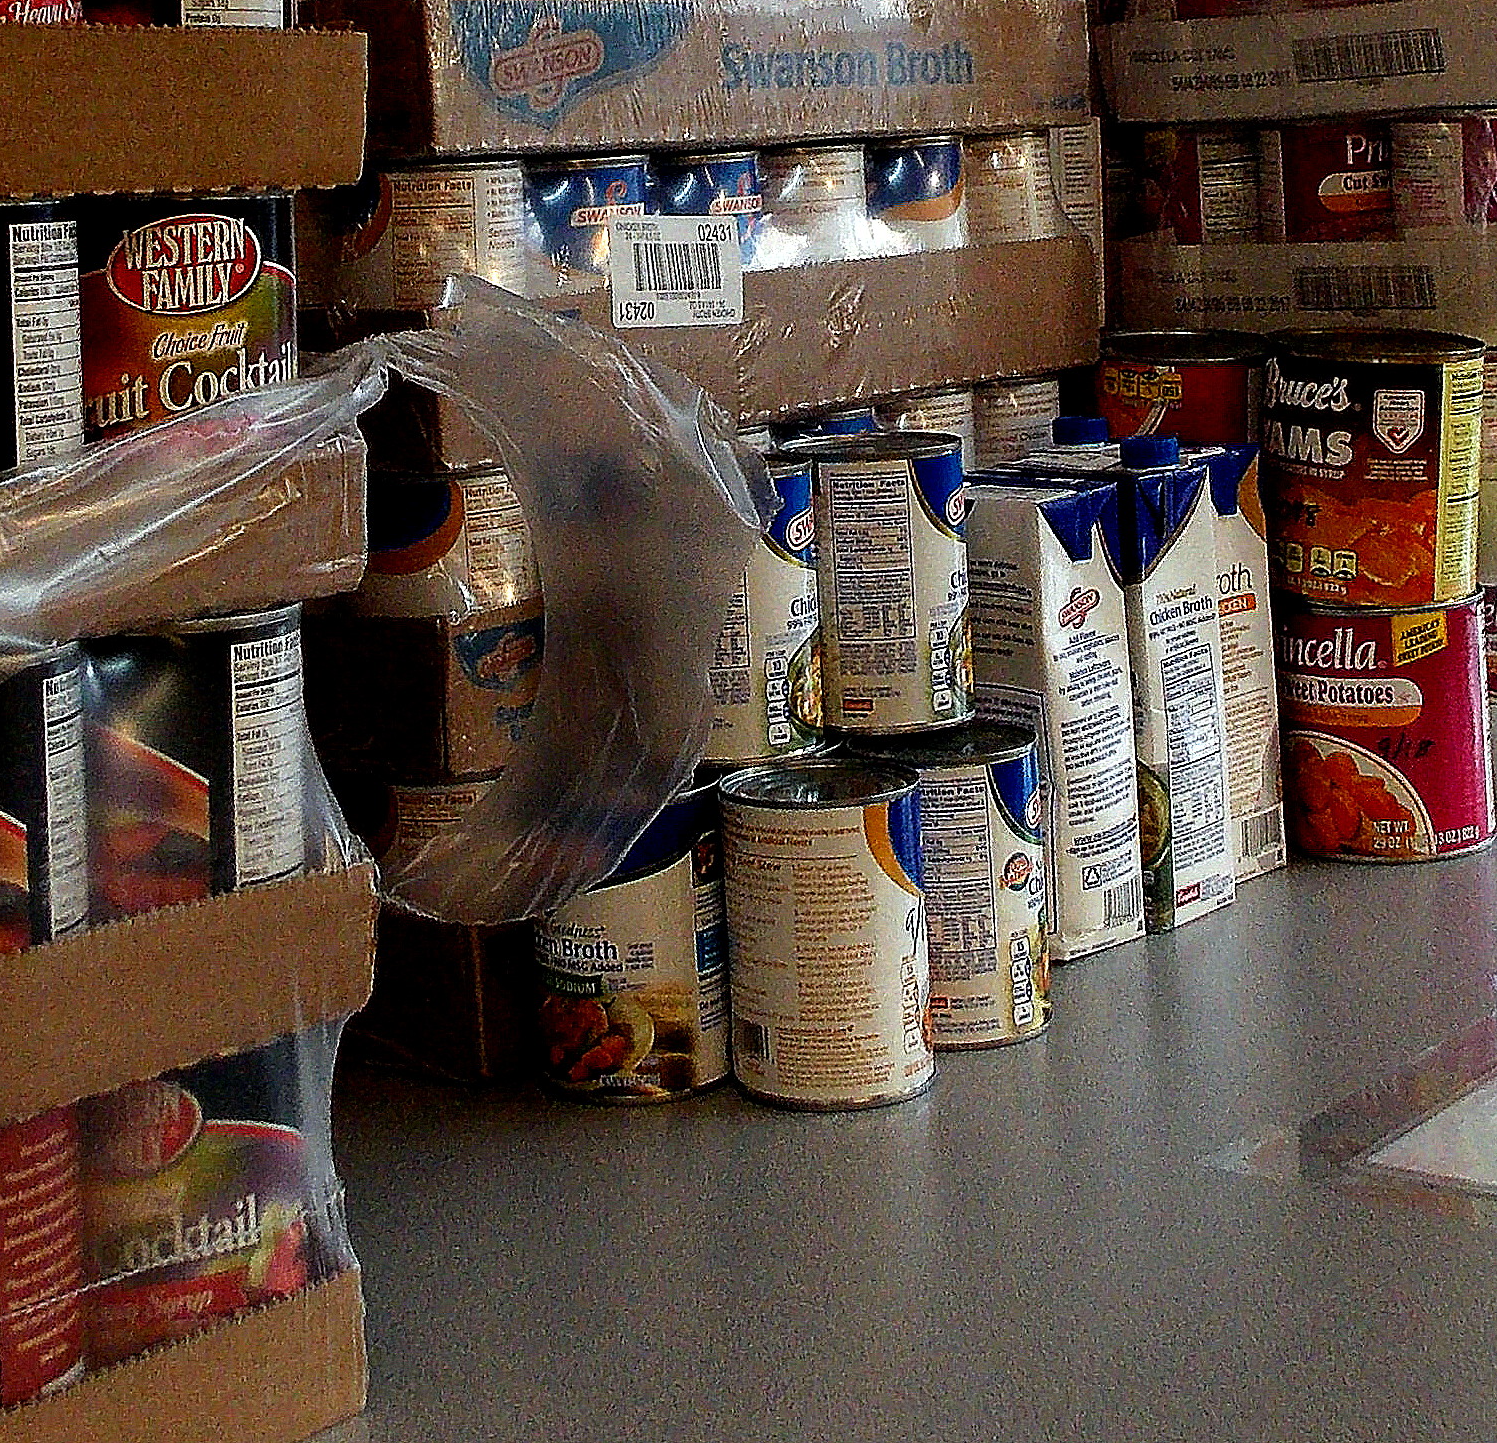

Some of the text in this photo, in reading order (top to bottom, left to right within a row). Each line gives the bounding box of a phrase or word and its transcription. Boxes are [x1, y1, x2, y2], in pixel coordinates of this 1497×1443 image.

[501, 48, 593, 82] SWANSON
[722, 43, 974, 90] Swanson Broth
[122, 218, 245, 270] WESTERN
[698, 224, 732, 241] 02431
[620, 301, 654, 321] 02431
[153, 320, 248, 359] Choice Fruit
[160, 342, 297, 411] Cocktail
[1269, 427, 1352, 465] AMS
[1149, 606, 1181, 626] Chicken
[1183, 597, 1212, 617] Broth
[233, 637, 283, 662] Nutrition
[1317, 679, 1394, 704] Potatoes
[562, 937, 617, 959] Broth
[590, 962, 623, 972] Added
